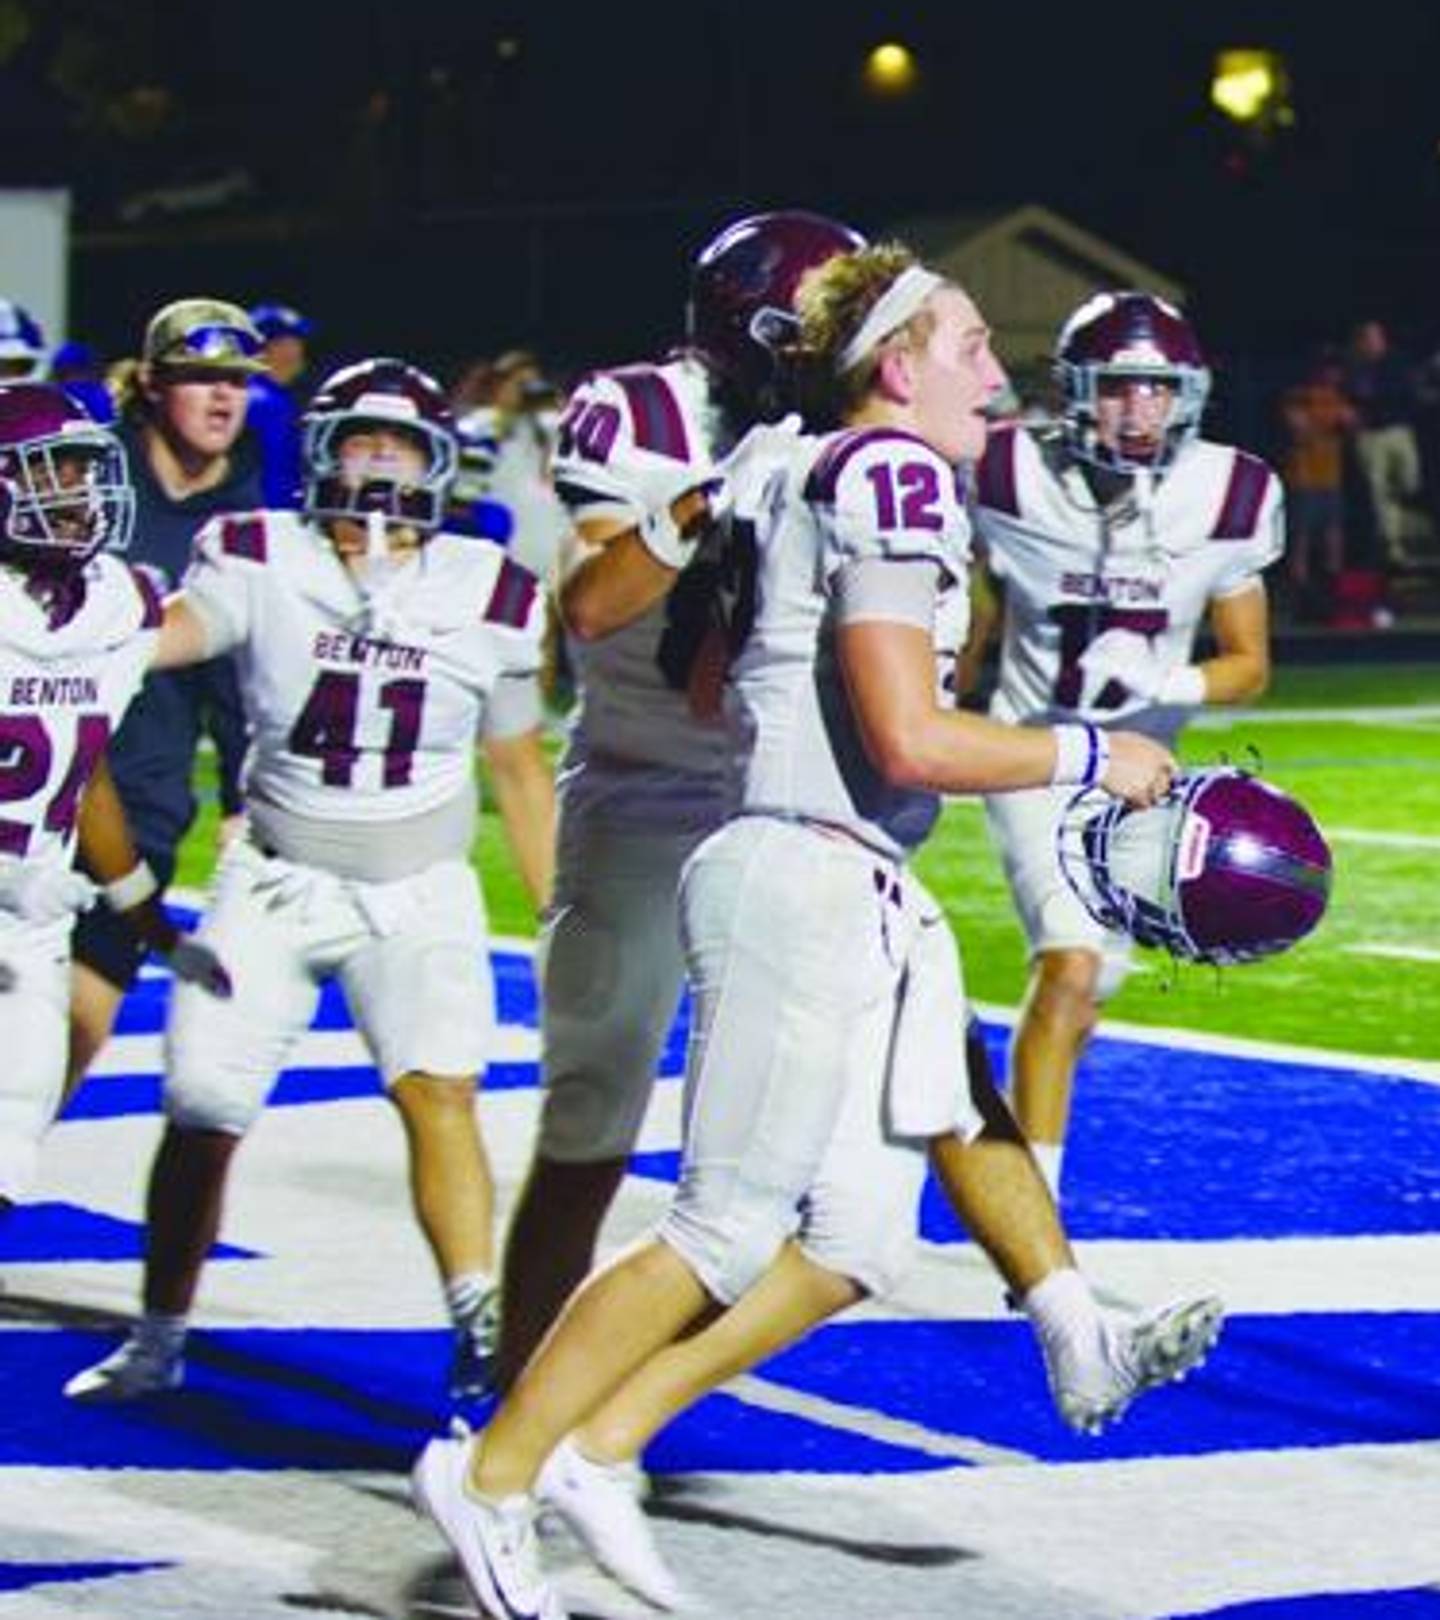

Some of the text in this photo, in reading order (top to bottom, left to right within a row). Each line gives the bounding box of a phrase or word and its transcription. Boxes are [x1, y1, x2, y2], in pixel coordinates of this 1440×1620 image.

[866, 462, 944, 531] 12
[10, 677, 98, 705] BENTON
[289, 670, 427, 788] 41
